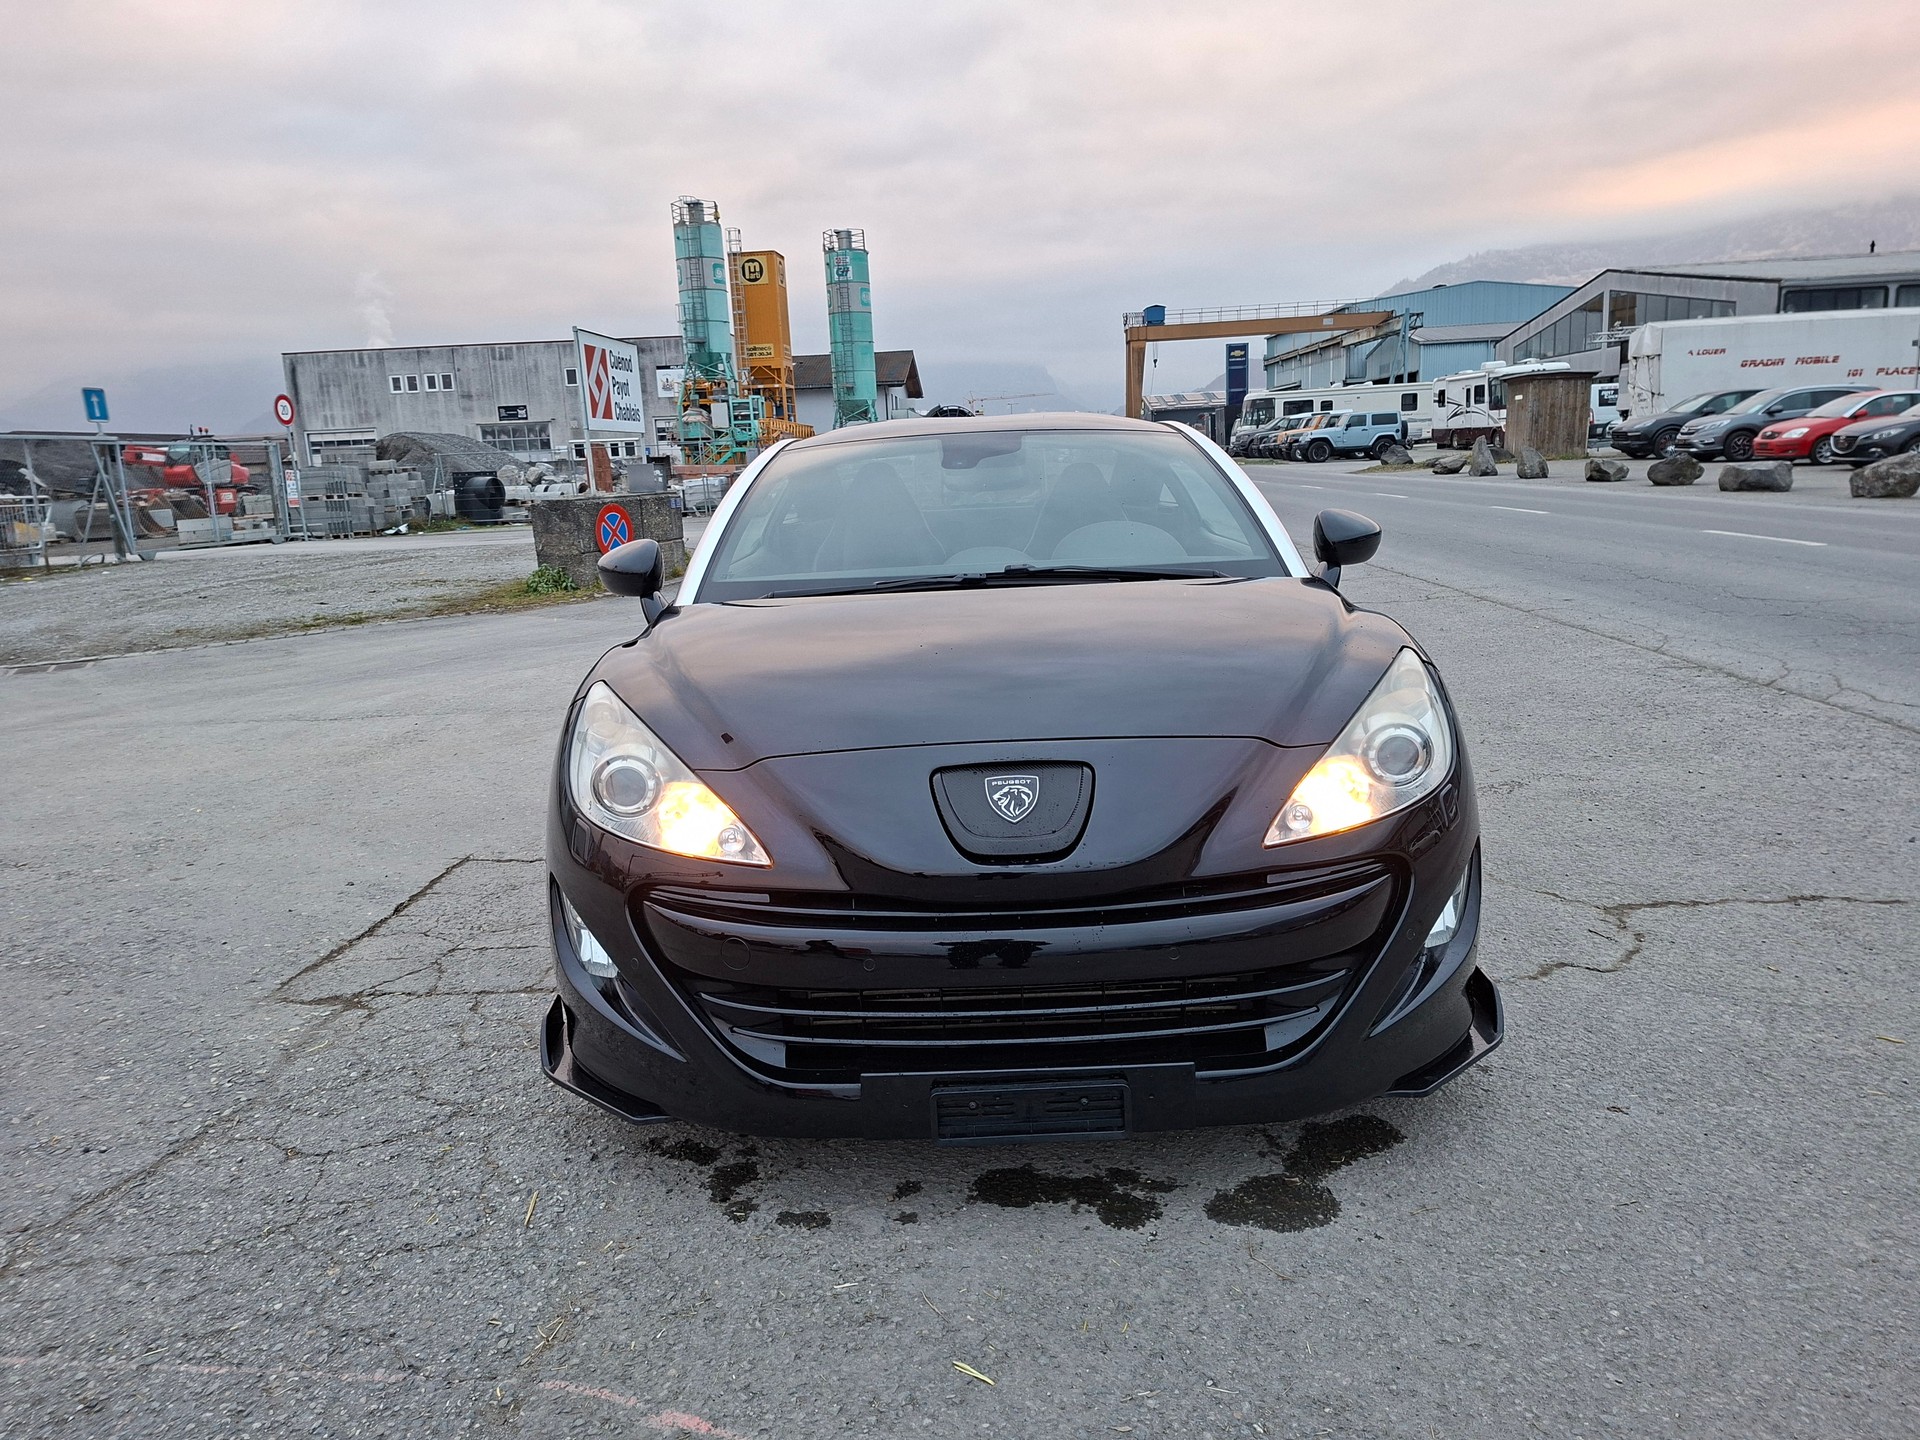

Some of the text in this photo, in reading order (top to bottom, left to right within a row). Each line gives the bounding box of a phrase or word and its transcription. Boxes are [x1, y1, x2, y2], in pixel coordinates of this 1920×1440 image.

[1696, 348, 1726, 356] LOUER
[609, 349, 633, 373] Cuénod
[1740, 355, 1840, 368] GRADIN MOBILE
[611, 375, 631, 400] Payot
[280, 404, 289, 416] 20
[614, 401, 641, 422] Chablais
[991, 779, 1032, 787] PEUGEOT
